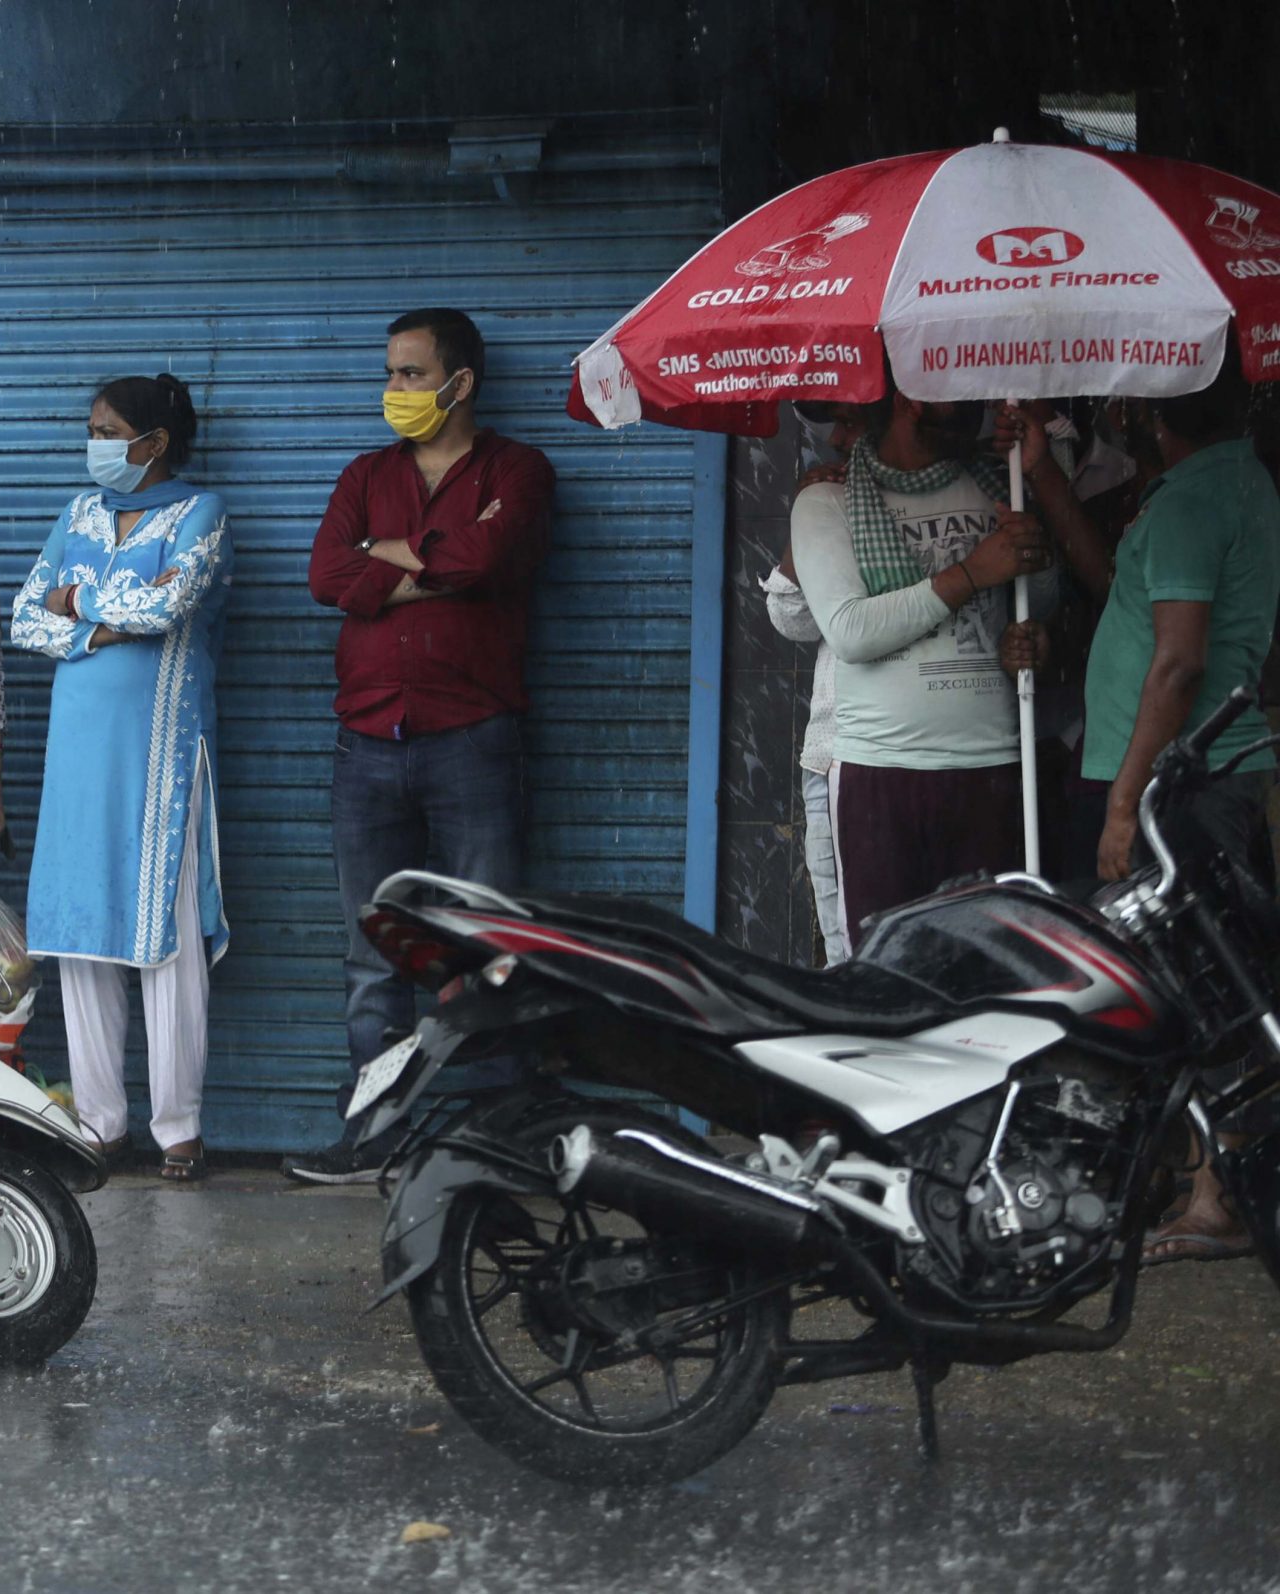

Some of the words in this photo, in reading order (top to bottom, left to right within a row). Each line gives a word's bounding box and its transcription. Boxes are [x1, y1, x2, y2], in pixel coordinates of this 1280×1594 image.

[687, 285, 770, 309] GOLD
[773, 277, 853, 300] LOAN
[918, 273, 1041, 298] Muthoot
[1049, 271, 1160, 288] Finance
[658, 353, 701, 377] SMS
[812, 344, 862, 365] 56161
[922, 346, 949, 372] NO
[954, 340, 1056, 368] JHANJHAT.
[1060, 338, 1115, 364] LOAN
[1121, 339, 1205, 367] FATAFAT.
[901, 514, 1000, 542] NTANA
